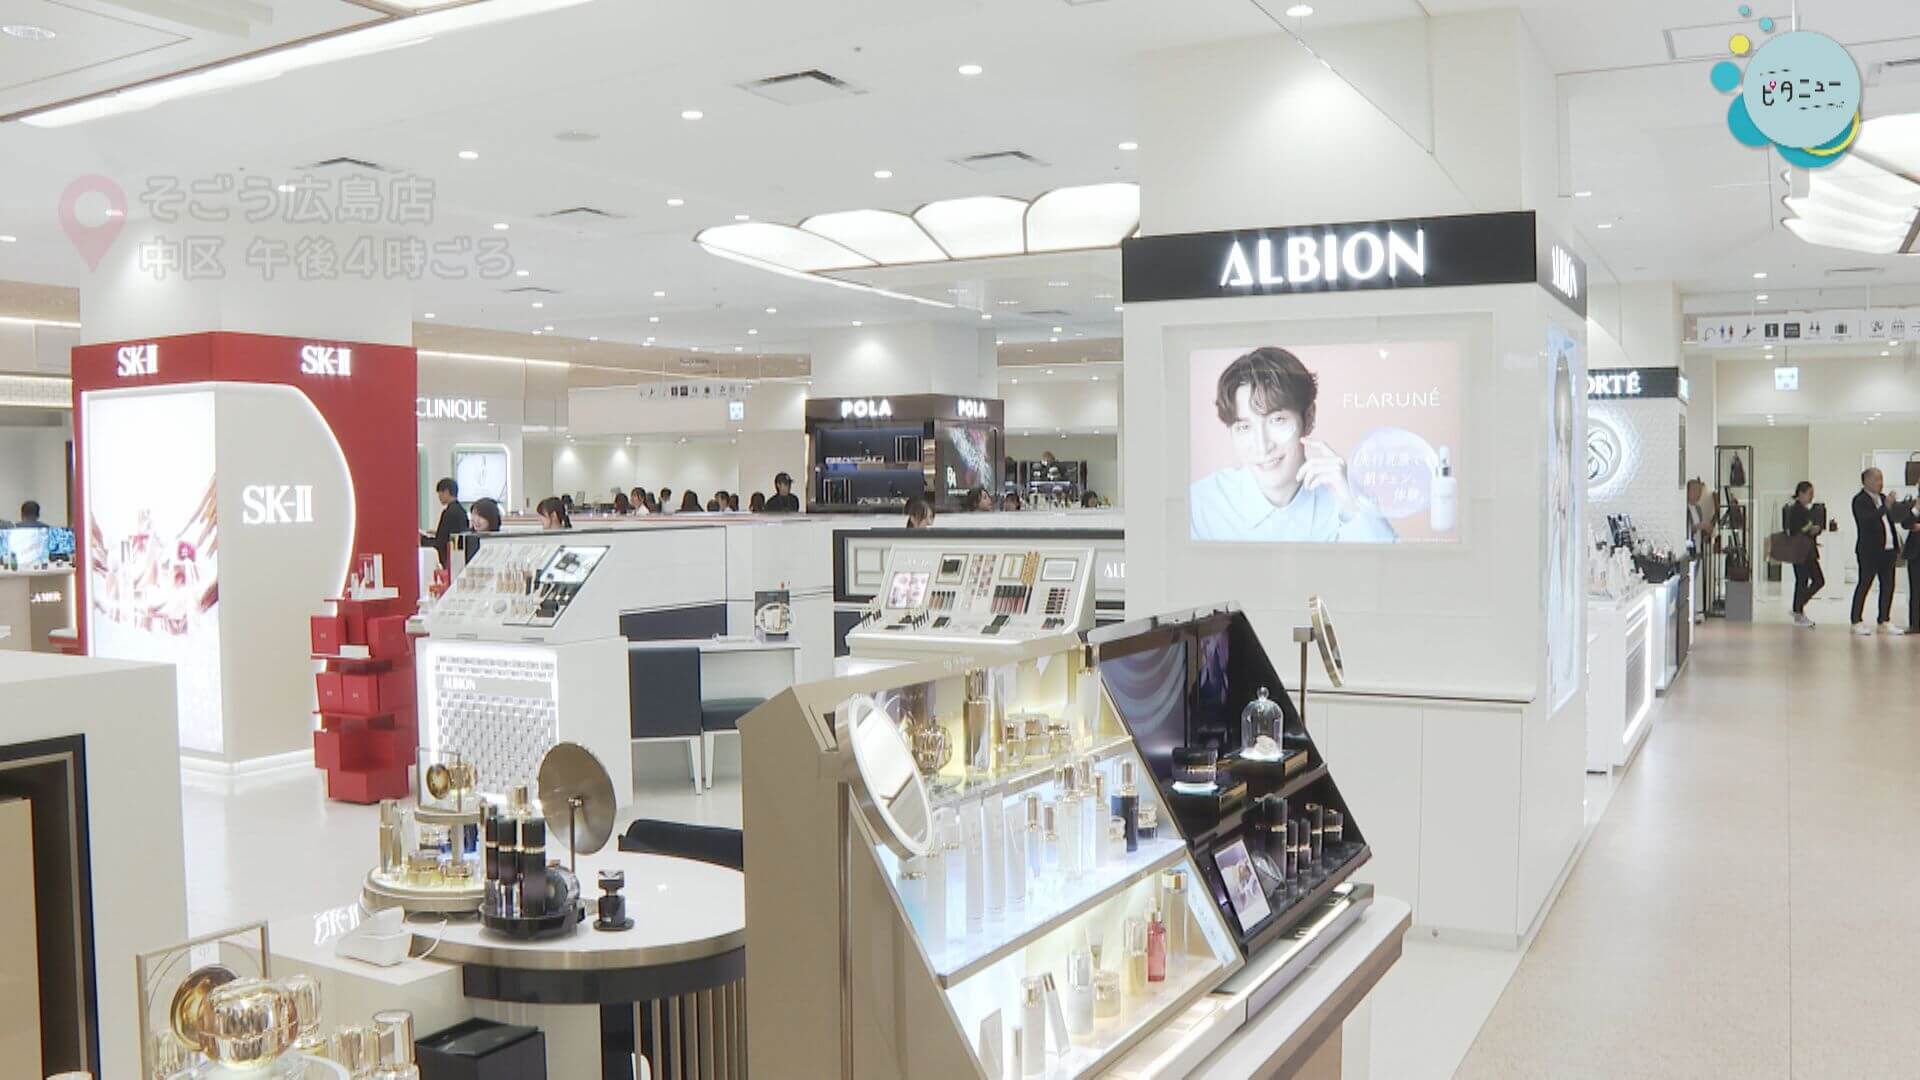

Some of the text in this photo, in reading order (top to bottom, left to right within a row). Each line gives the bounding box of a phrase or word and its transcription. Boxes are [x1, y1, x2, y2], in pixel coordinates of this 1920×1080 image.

[1219, 229, 1424, 287] ALBION
[117, 344, 158, 376] SK-II
[301, 346, 351, 376] SK-II
[417, 398, 487, 420] CLINIQUE
[841, 400, 892, 418] POLA
[958, 400, 986, 418] POLA
[1343, 386, 1441, 408] FLARUNÉ
[242, 485, 314, 525] SK-II
